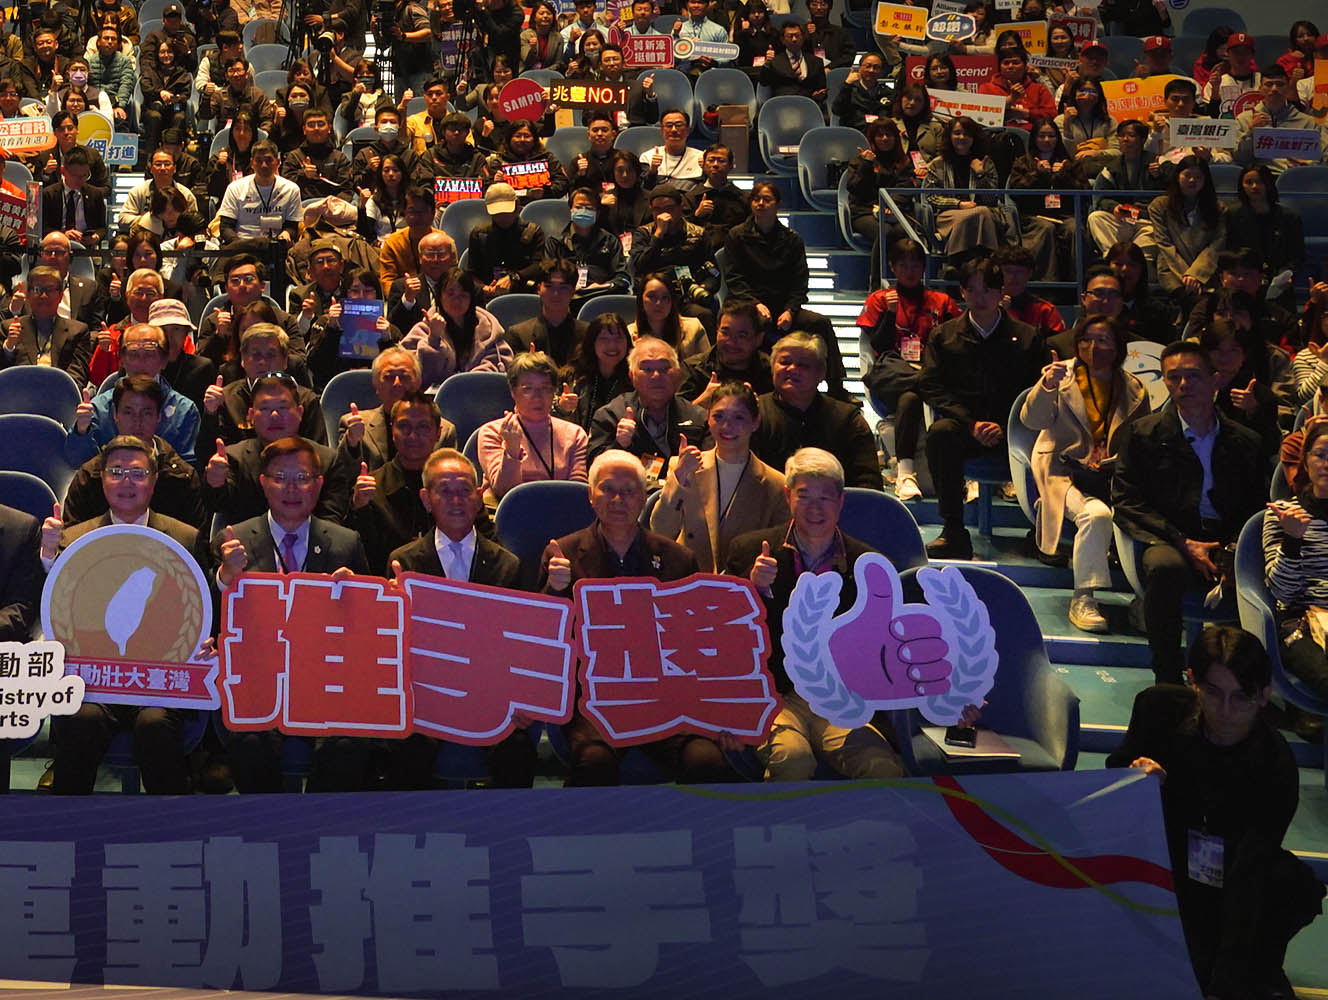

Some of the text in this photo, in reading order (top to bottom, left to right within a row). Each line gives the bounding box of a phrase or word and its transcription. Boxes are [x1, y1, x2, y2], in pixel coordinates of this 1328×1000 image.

[1030, 56, 1077, 69] Transcend
[955, 65, 989, 78] scend
[503, 92, 543, 112] SAMPO
[1177, 124, 1230, 136] 臺灣銀行
[504, 161, 546, 177] YAMAHA
[435, 179, 480, 192] YAMAHA
[226, 578, 776, 741] 推手獎
[51, 686, 74, 705] of
